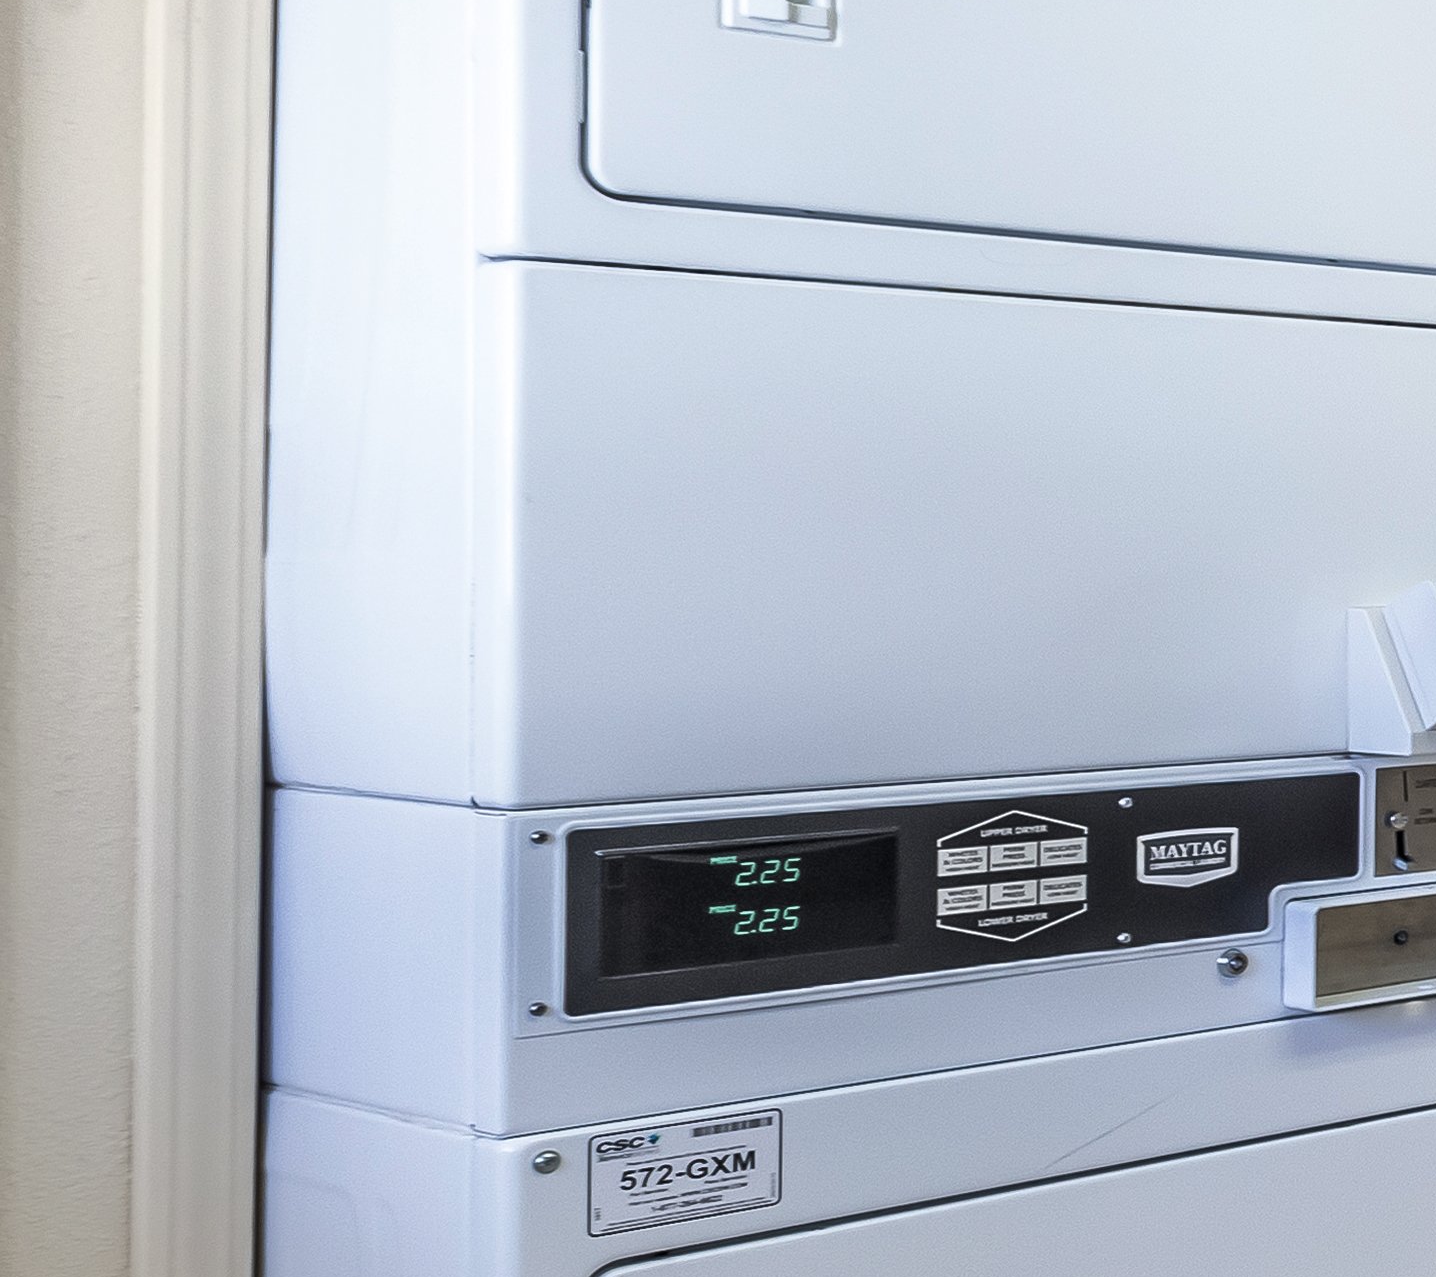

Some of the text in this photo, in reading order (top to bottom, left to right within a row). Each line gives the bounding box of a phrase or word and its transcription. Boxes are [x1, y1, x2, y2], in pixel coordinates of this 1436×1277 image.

[1150, 839, 1227, 861] MAYTAG
[735, 858, 801, 886] 2.25
[734, 906, 800, 935] 2.25
[596, 1136, 645, 1154] CSC
[620, 1150, 756, 1191] 572-GXM
